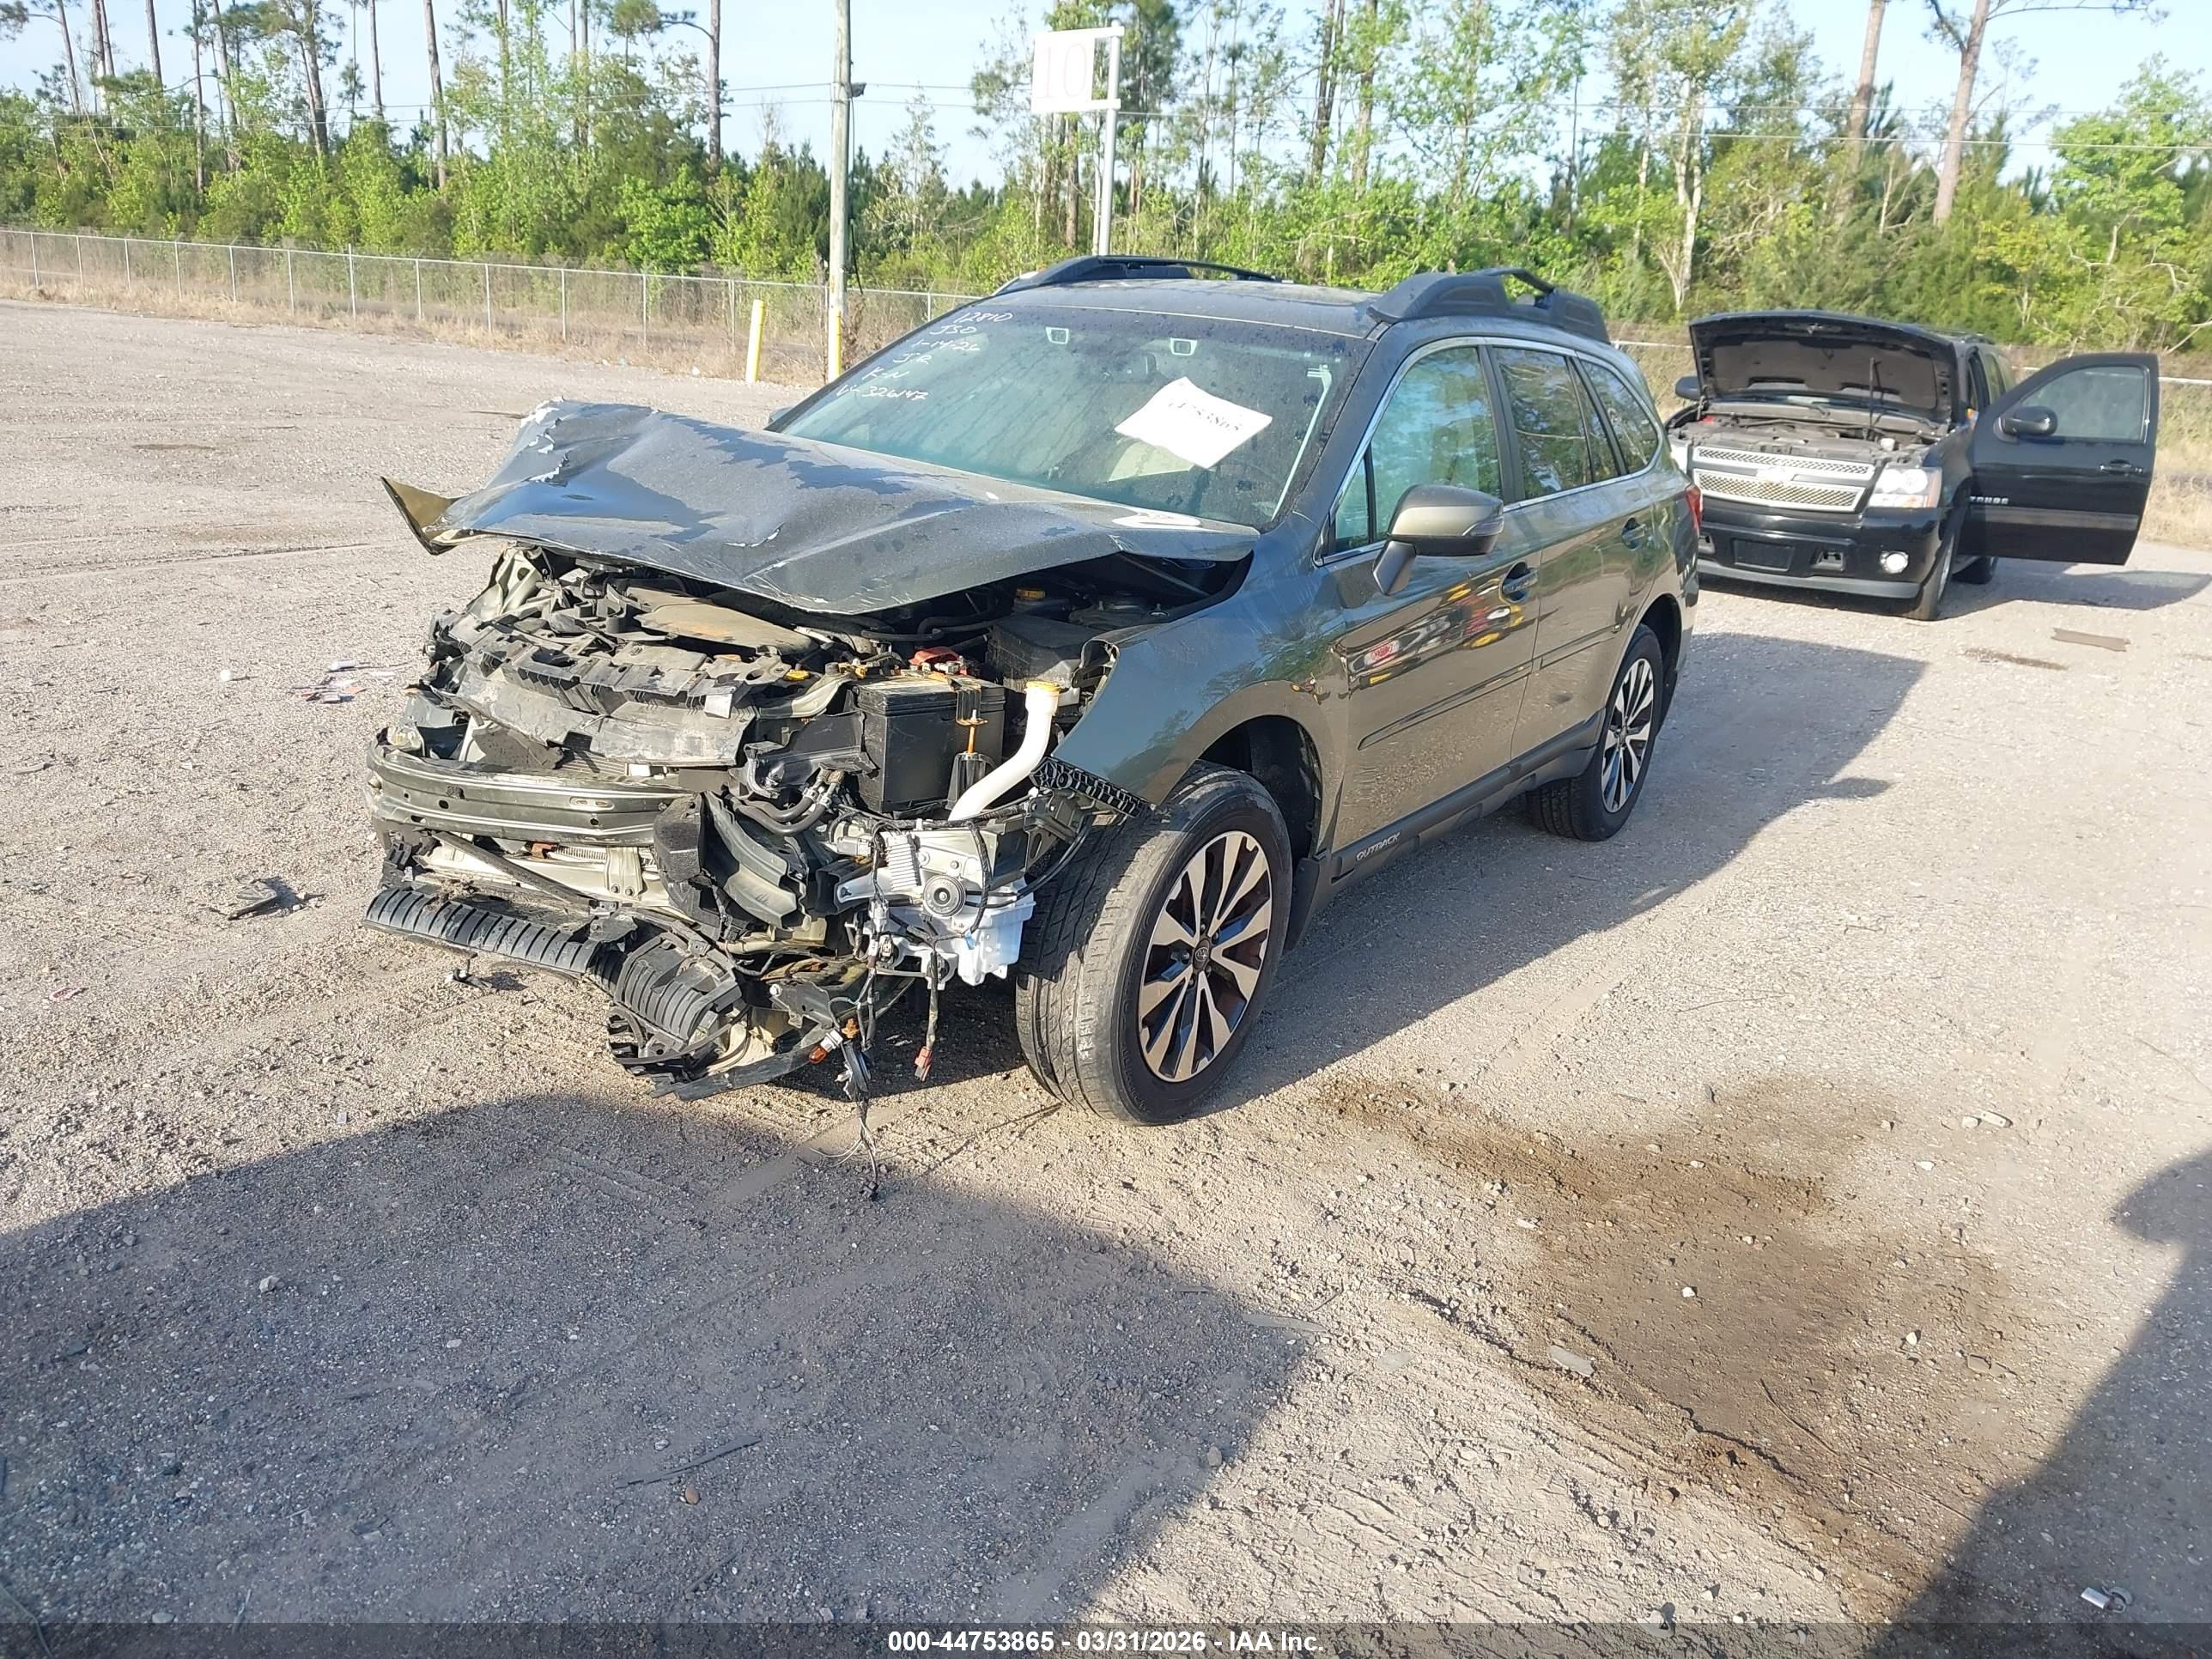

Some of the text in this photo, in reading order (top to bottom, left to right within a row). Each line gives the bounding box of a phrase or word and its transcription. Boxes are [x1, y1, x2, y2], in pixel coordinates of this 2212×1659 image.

[1036, 42, 1088, 99] 10
[953, 312, 1013, 324] 12810
[1356, 831, 1401, 861] OUTBACK
